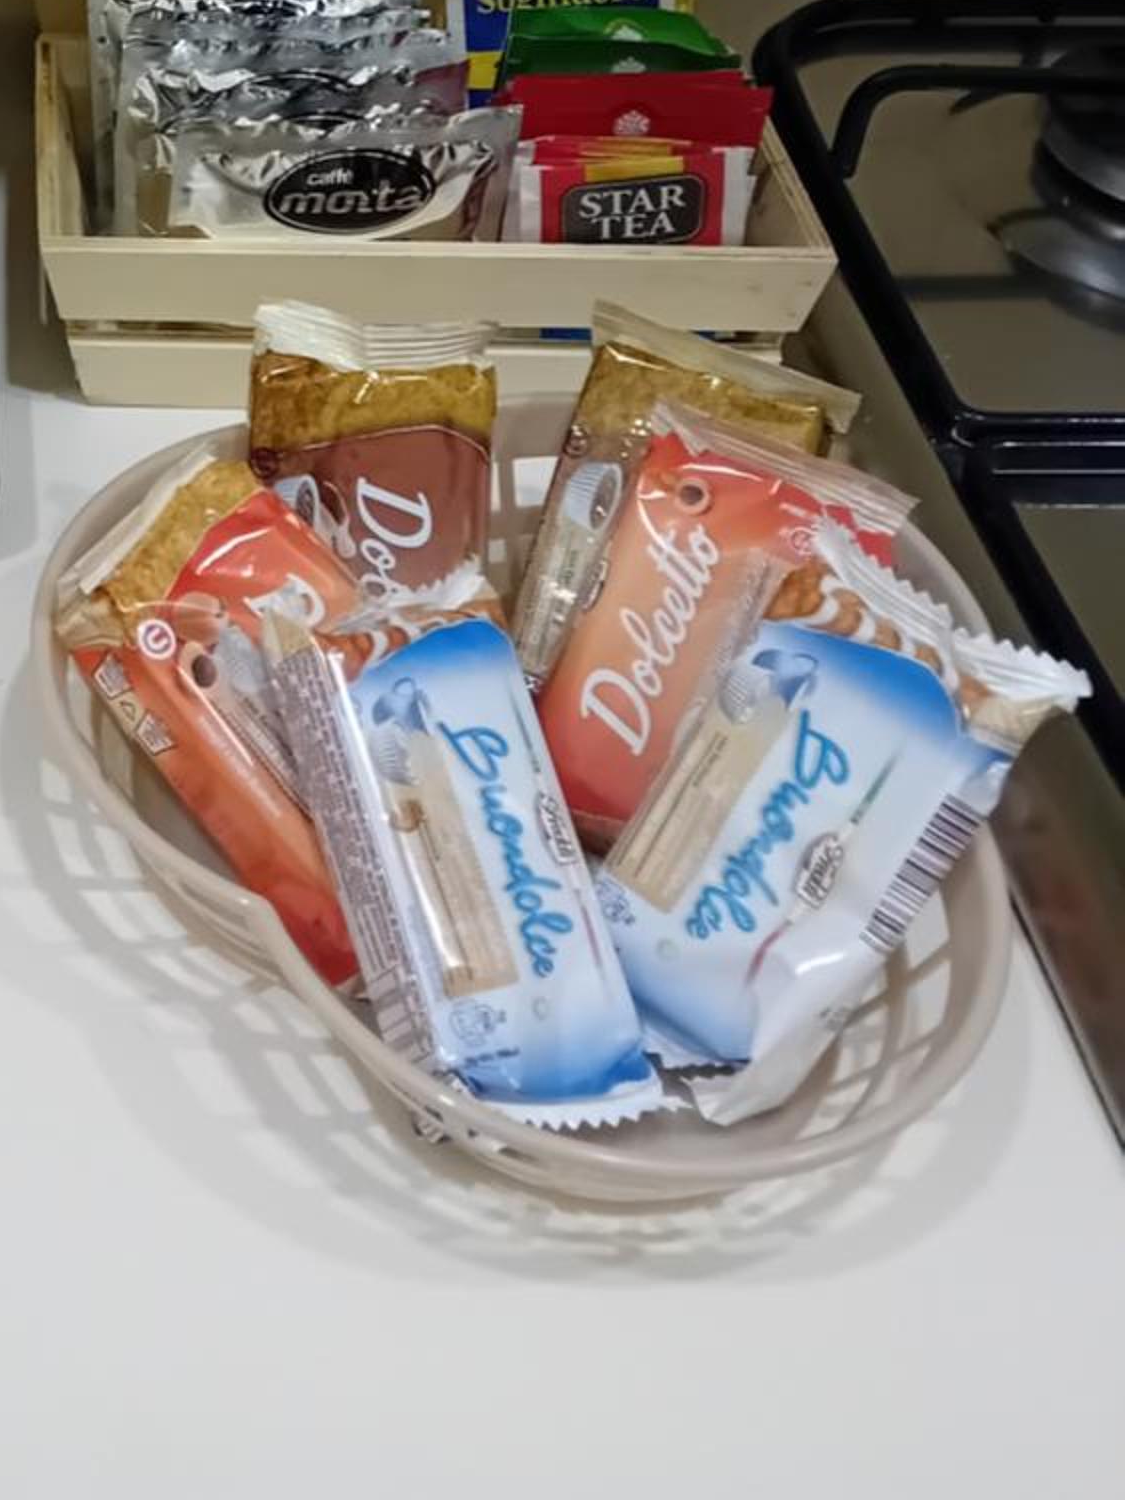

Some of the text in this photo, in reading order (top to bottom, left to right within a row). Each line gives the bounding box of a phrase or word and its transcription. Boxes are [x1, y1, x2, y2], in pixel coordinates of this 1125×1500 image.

[578, 184, 687, 219] STAR
[590, 211, 676, 240] TEA
[580, 521, 721, 757] Dolcetto
[437, 719, 574, 979] Buondolce
[684, 708, 850, 941] Buondolce
